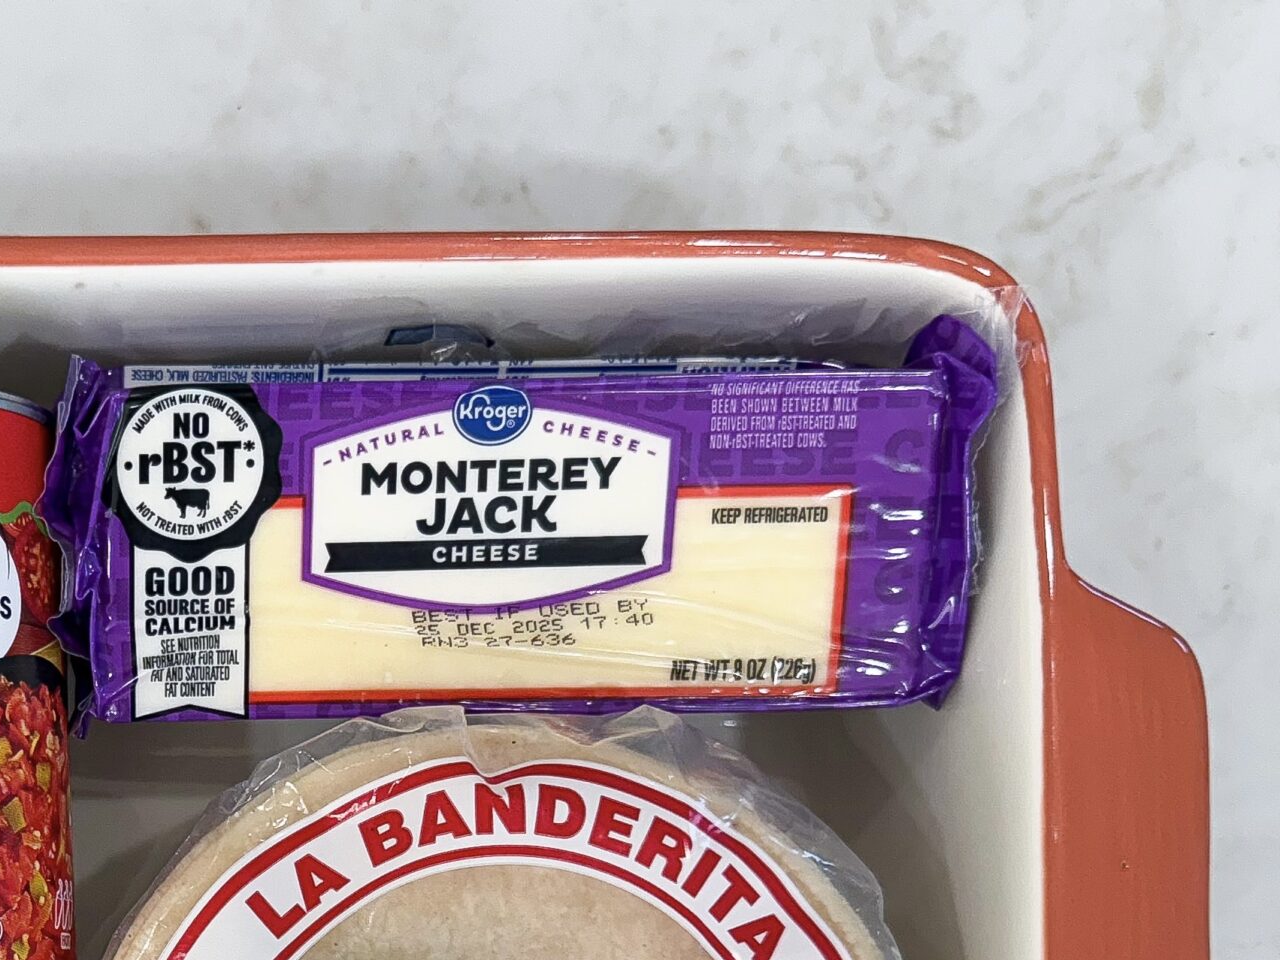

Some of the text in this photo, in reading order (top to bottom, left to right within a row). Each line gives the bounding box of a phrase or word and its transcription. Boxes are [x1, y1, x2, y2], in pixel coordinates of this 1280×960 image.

[131, 393, 249, 434] MADE WITH MILK FROM COWS
[459, 394, 527, 431] Kroger
[711, 396, 859, 414] BEEN SHOWN BETWEEN MILK
[173, 412, 210, 440] NO
[710, 415, 749, 432] DERIVED
[750, 415, 776, 432] FROM
[837, 414, 857, 430] AND
[339, 420, 641, 462] NATURAL CHEESE
[361, 456, 622, 496] MONTEREY
[136, 501, 153, 522] NOT
[154, 516, 195, 536] TREATED
[196, 519, 223, 536] WITH
[416, 494, 558, 536] JACK
[711, 506, 829, 525] KEEP REFRIGERATED
[431, 544, 540, 564] CHEESE
[144, 565, 236, 597] GOOD
[144, 598, 236, 617] SOURCE OF
[412, 598, 649, 625] BEST IF USED BY
[144, 615, 236, 637] CALCIUM
[415, 623, 441, 636] 25
[457, 621, 495, 637] DEC
[513, 618, 565, 634] 2025
[160, 634, 221, 654] SEE NUTRITION
[142, 649, 240, 671] INFORMATION FOR TOTAL
[670, 659, 698, 681] NET
[704, 659, 730, 681] WT
[747, 658, 768, 681] OZ
[150, 665, 230, 683] FAT AND SATURATED
[164, 681, 217, 698] FAT CONTENT
[245, 851, 351, 940] LA
